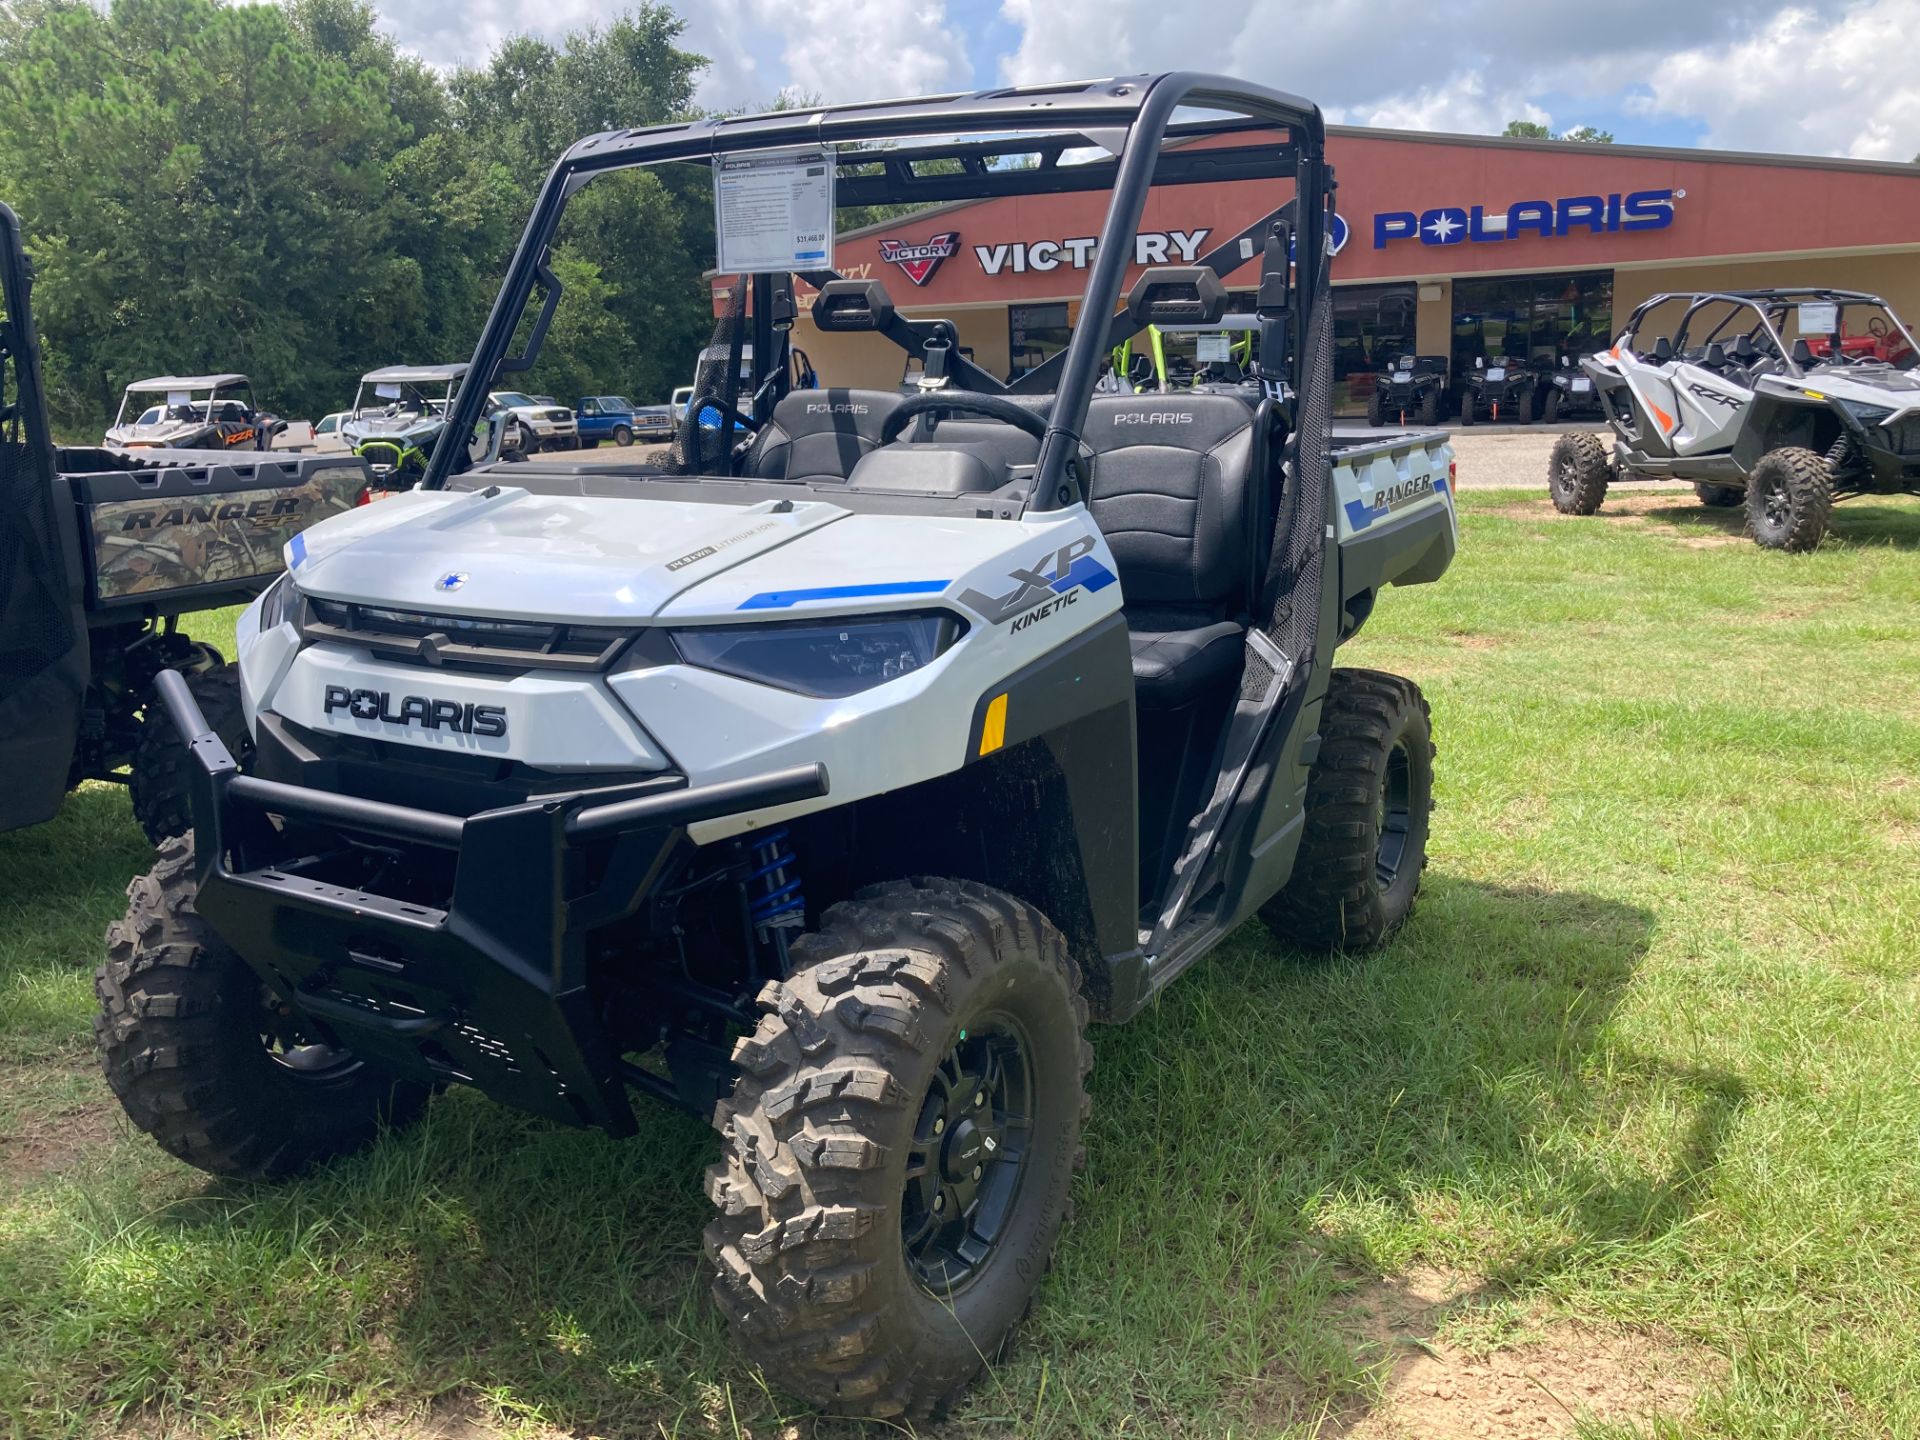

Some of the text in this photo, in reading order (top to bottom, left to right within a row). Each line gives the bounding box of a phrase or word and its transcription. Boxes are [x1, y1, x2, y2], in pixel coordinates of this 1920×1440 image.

[1373, 189, 1675, 249] POLARIS
[884, 245, 950, 260] VICTORY
[974, 229, 1213, 275] VICTRY
[807, 404, 868, 414] POLARIS
[1688, 383, 1744, 411] RZR
[1114, 412, 1193, 425] POLARIS
[226, 429, 253, 446] RZR
[1373, 474, 1430, 511] RANGER
[122, 498, 299, 531] RANGER
[252, 514, 303, 528] SP
[715, 530, 755, 551] LITHIUM
[1002, 534, 1097, 609] XP
[1010, 589, 1079, 635] KINETIC
[324, 684, 507, 738] POLARIS
